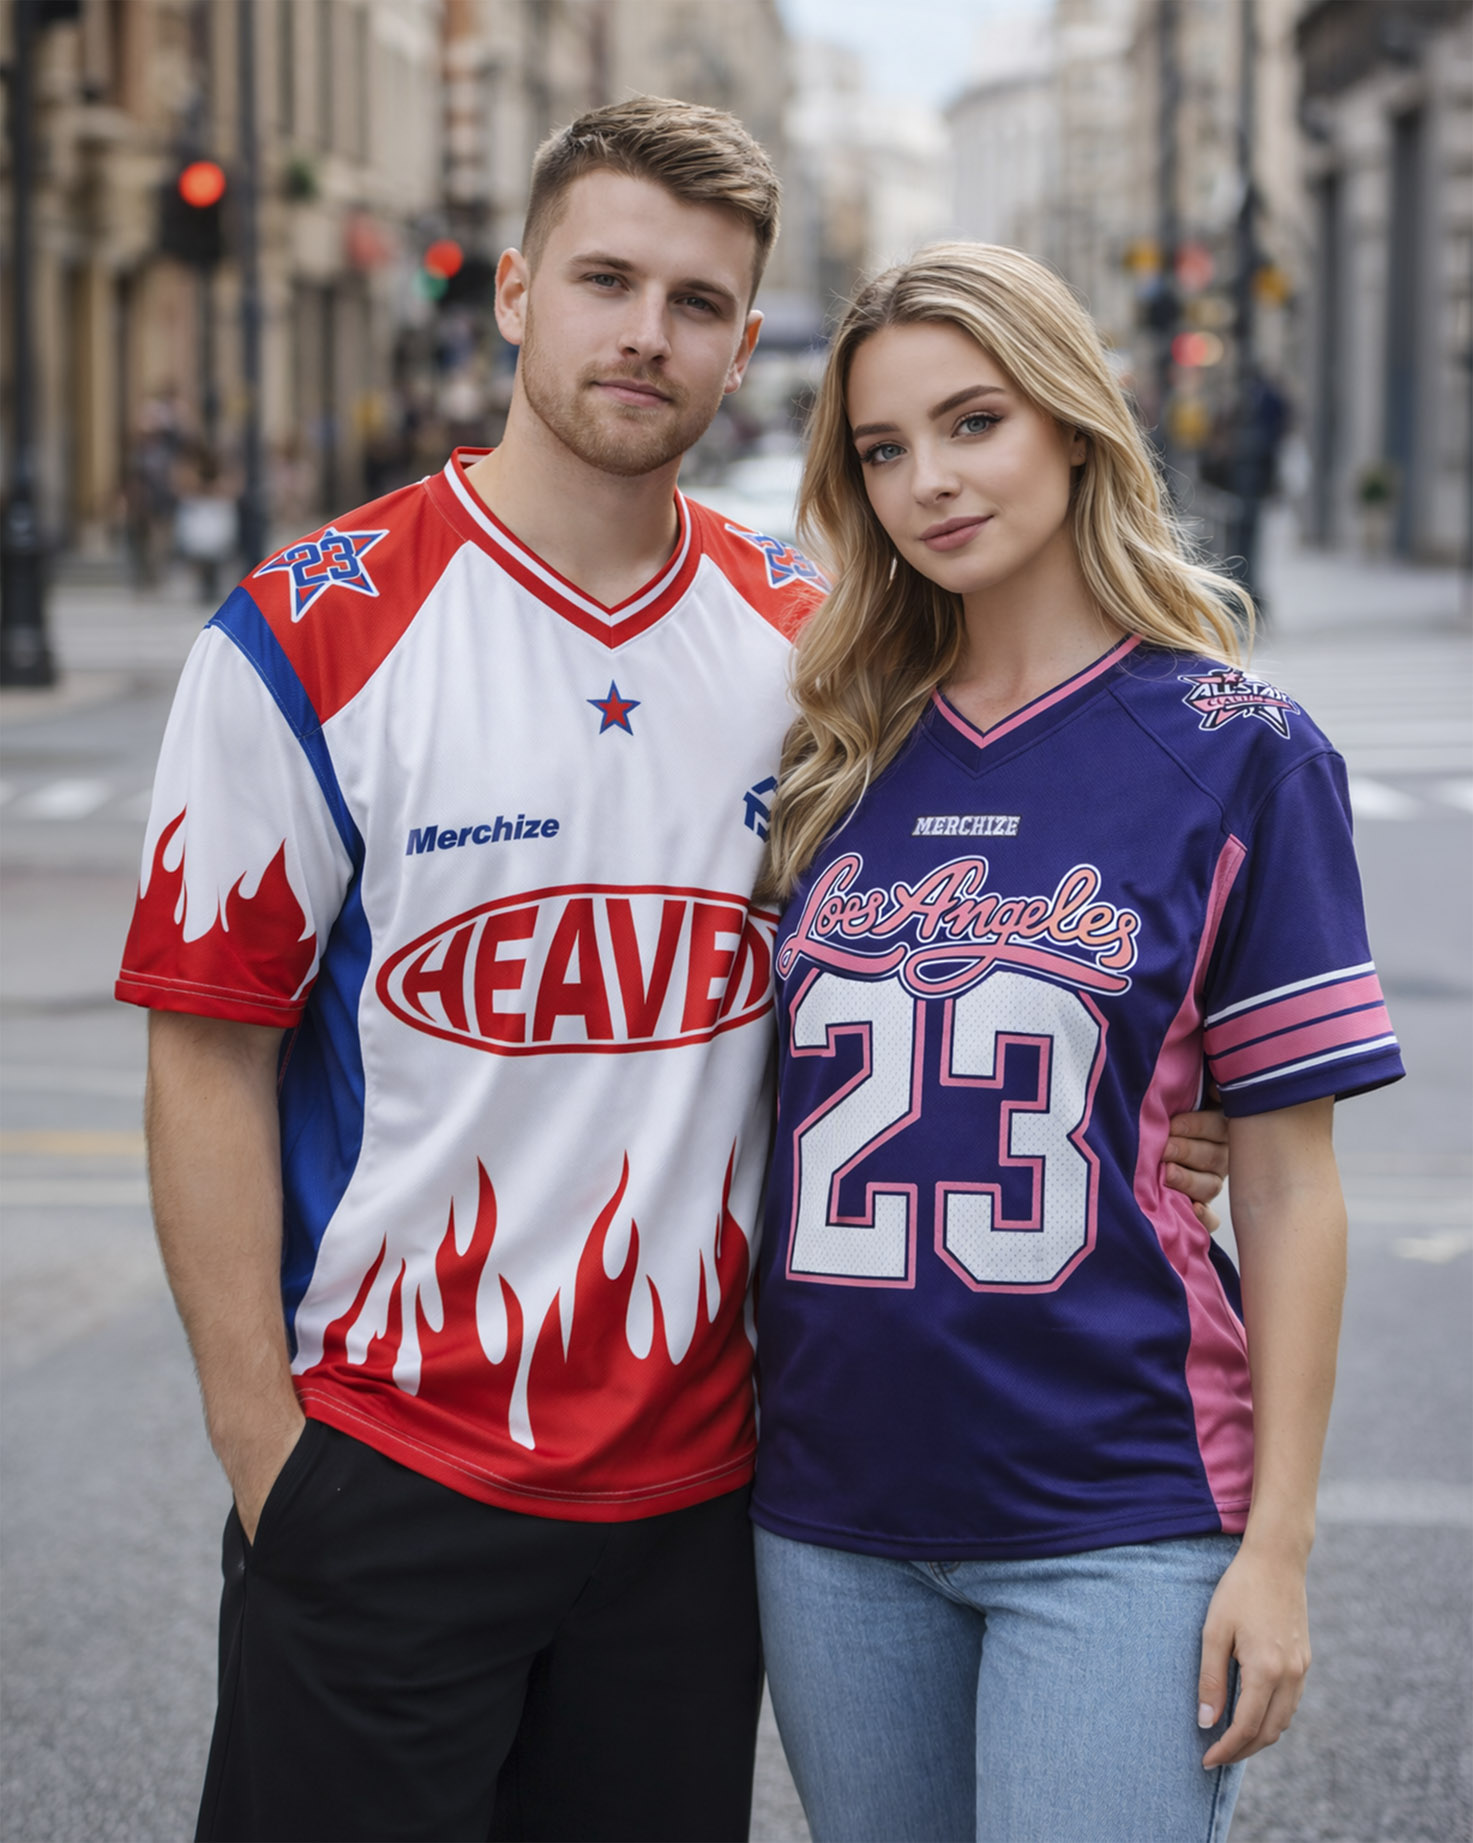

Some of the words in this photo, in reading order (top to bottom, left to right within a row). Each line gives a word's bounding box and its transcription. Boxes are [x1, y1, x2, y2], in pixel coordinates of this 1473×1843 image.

[284, 535, 361, 588] 23
[405, 813, 560, 856] Merchize
[911, 815, 1021, 836] MERCHIZE
[871, 852, 1142, 998] Angeles
[786, 966, 1110, 1294] 23
